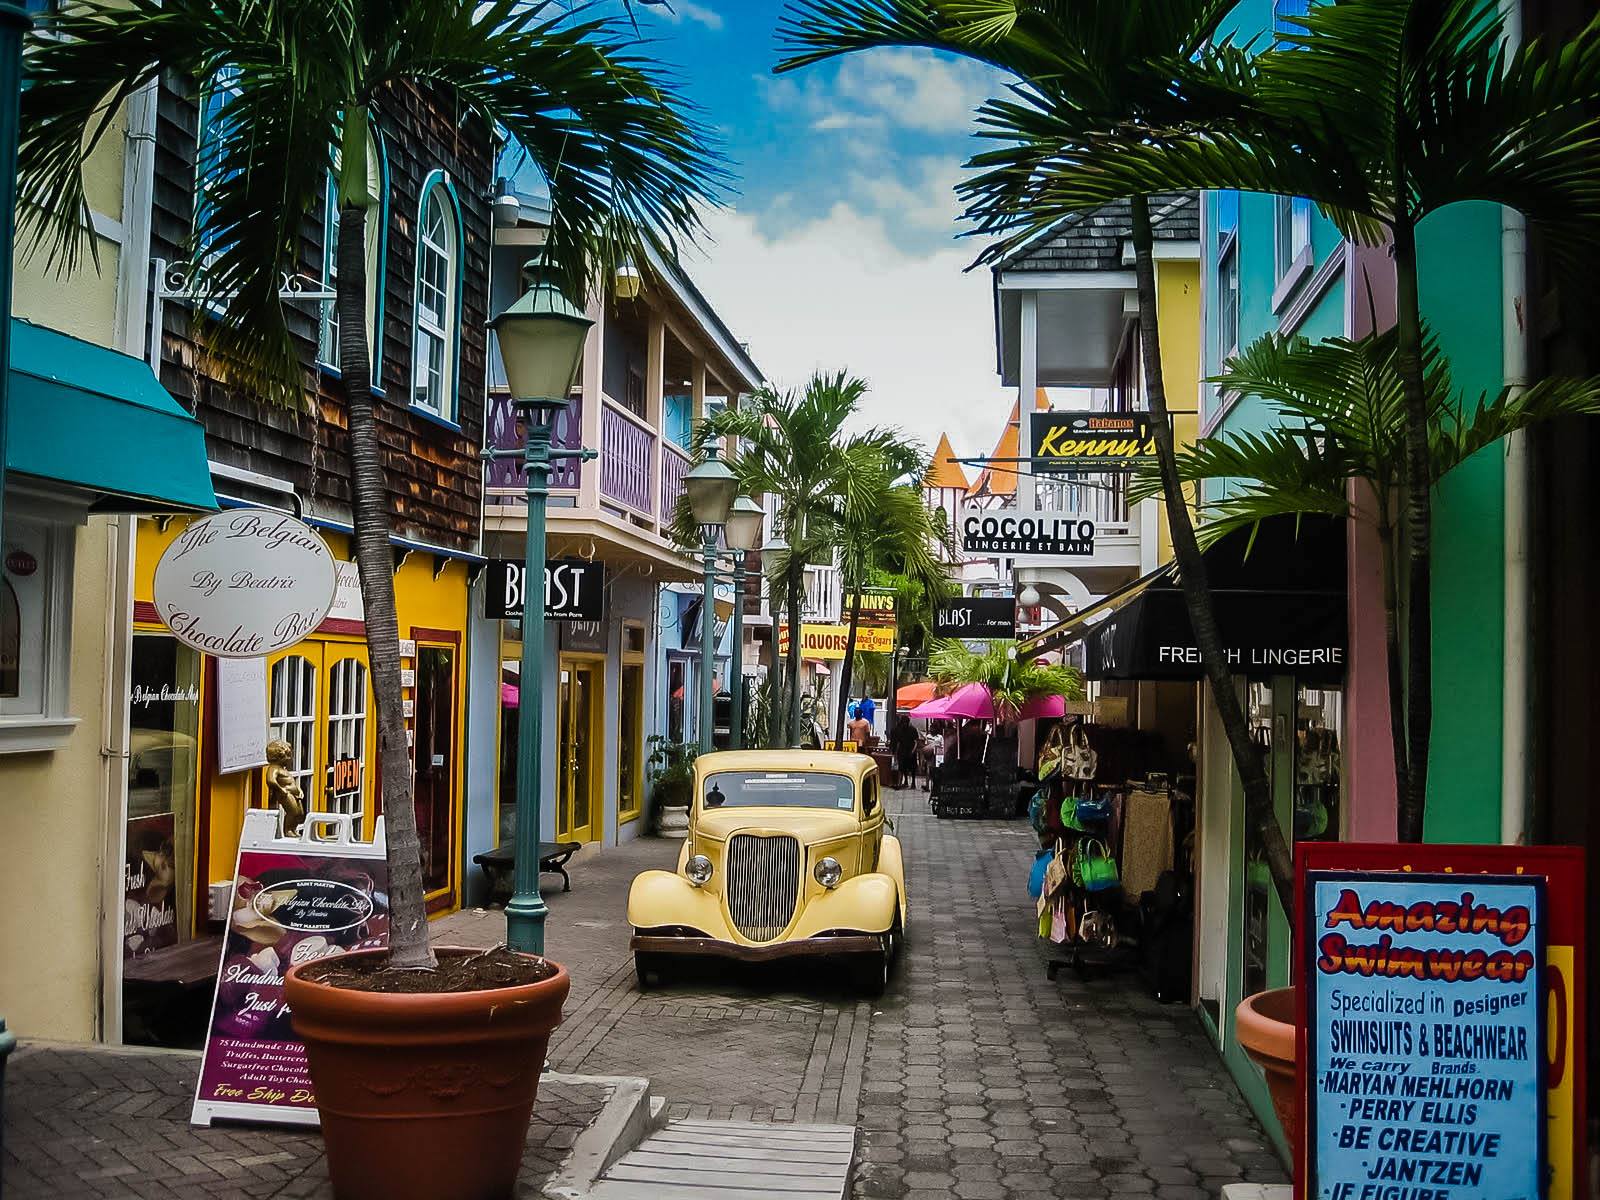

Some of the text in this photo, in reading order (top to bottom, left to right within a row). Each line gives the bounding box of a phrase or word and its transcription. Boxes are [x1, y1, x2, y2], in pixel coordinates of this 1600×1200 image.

[1089, 418, 1134, 428] Habanos
[1038, 424, 1157, 458] Kenny's
[173, 515, 322, 561] The Belgian
[964, 517, 1095, 541] COCOLITO
[967, 540, 1091, 552] LINGERIE ET BAIN
[190, 570, 297, 597] By Beatrix
[845, 593, 894, 611] KNNY'S
[168, 603, 319, 652] Chocolate Bar
[938, 607, 973, 627] BLAST
[801, 633, 849, 651] IQUORS
[1159, 646, 1343, 665] FREH LINGERIE
[336, 759, 359, 791] OPEN
[1325, 889, 1532, 947] Amazing
[1317, 932, 1534, 983] Swimwear
[225, 963, 285, 986] Handma
[237, 991, 278, 1016] Just
[1330, 989, 1529, 1018] Specialized in Designer
[230, 1039, 282, 1051] Handmade
[1331, 1019, 1528, 1061] SWIMSUITS & BEACHWEAR
[260, 1052, 309, 1063] Buttercre
[271, 1063, 309, 1074] Chocola
[1330, 1056, 1357, 1070] We
[1361, 1060, 1412, 1075] carry
[239, 1072, 267, 1081] Adult
[285, 1076, 313, 1085] Choc
[1324, 1070, 1514, 1101] MARYAN MEHLHORN
[213, 1083, 244, 1097] Free
[246, 1086, 286, 1104] Ship
[1348, 1098, 1478, 1126] PERRY ELLIS
[1338, 1125, 1502, 1158] BE CREATIVE
[1367, 1157, 1483, 1187] JANTZEN
